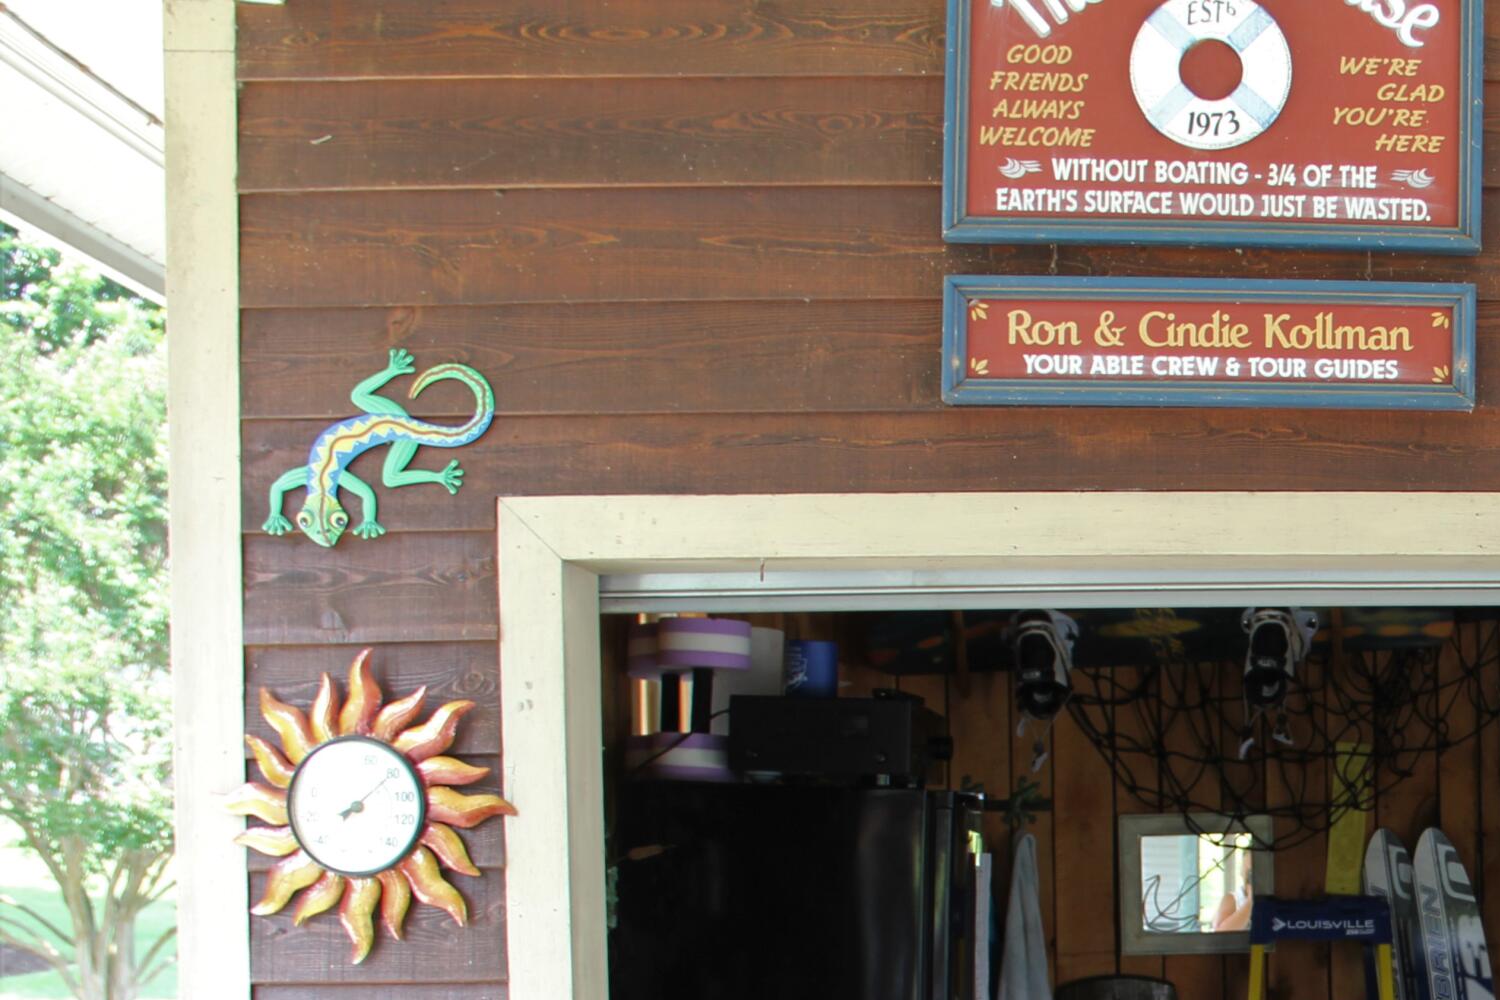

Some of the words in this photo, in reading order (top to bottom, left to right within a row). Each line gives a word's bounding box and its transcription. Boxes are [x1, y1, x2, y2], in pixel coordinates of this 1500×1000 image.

[1006, 44, 1072, 65] GOOD
[1339, 56, 1422, 77] WE'RE
[989, 70, 1089, 92] FRIENDS
[1376, 83, 1445, 103] GLAD
[992, 98, 1085, 120] ALWAYS
[1332, 106, 1427, 127] YOU'RE
[1187, 110, 1241, 137] 1973
[979, 126, 1096, 147] WELCOME
[1374, 134, 1445, 153] HERE
[1051, 157, 1149, 182] WITHOUT
[1154, 160, 1249, 186] BOATING
[1267, 163, 1297, 187] 3/4
[1302, 164, 1333, 187] OF
[1339, 165, 1378, 189] THE
[995, 187, 1078, 213] EARTH'S
[1084, 190, 1173, 214] SURFACE
[1178, 192, 1255, 217] WOULD
[1260, 194, 1307, 218] JUST
[1312, 195, 1338, 219] BE
[1344, 196, 1431, 222] WASTED.
[1007, 309, 1082, 346] Ron
[1094, 310, 1127, 347] &
[1138, 310, 1253, 349] Cindie
[1263, 311, 1415, 351] Kollman
[1023, 354, 1082, 375] YOUR
[1090, 354, 1145, 376] ABLE
[1151, 355, 1219, 377] CREW
[1225, 356, 1241, 377] &
[1248, 357, 1307, 379] TOUR
[1313, 358, 1399, 380] GUIDES
[386, 768, 400, 779] 80
[394, 792, 415, 802] 100
[394, 814, 415, 825] 120
[1287, 918, 1375, 930] LOUISVILLE
